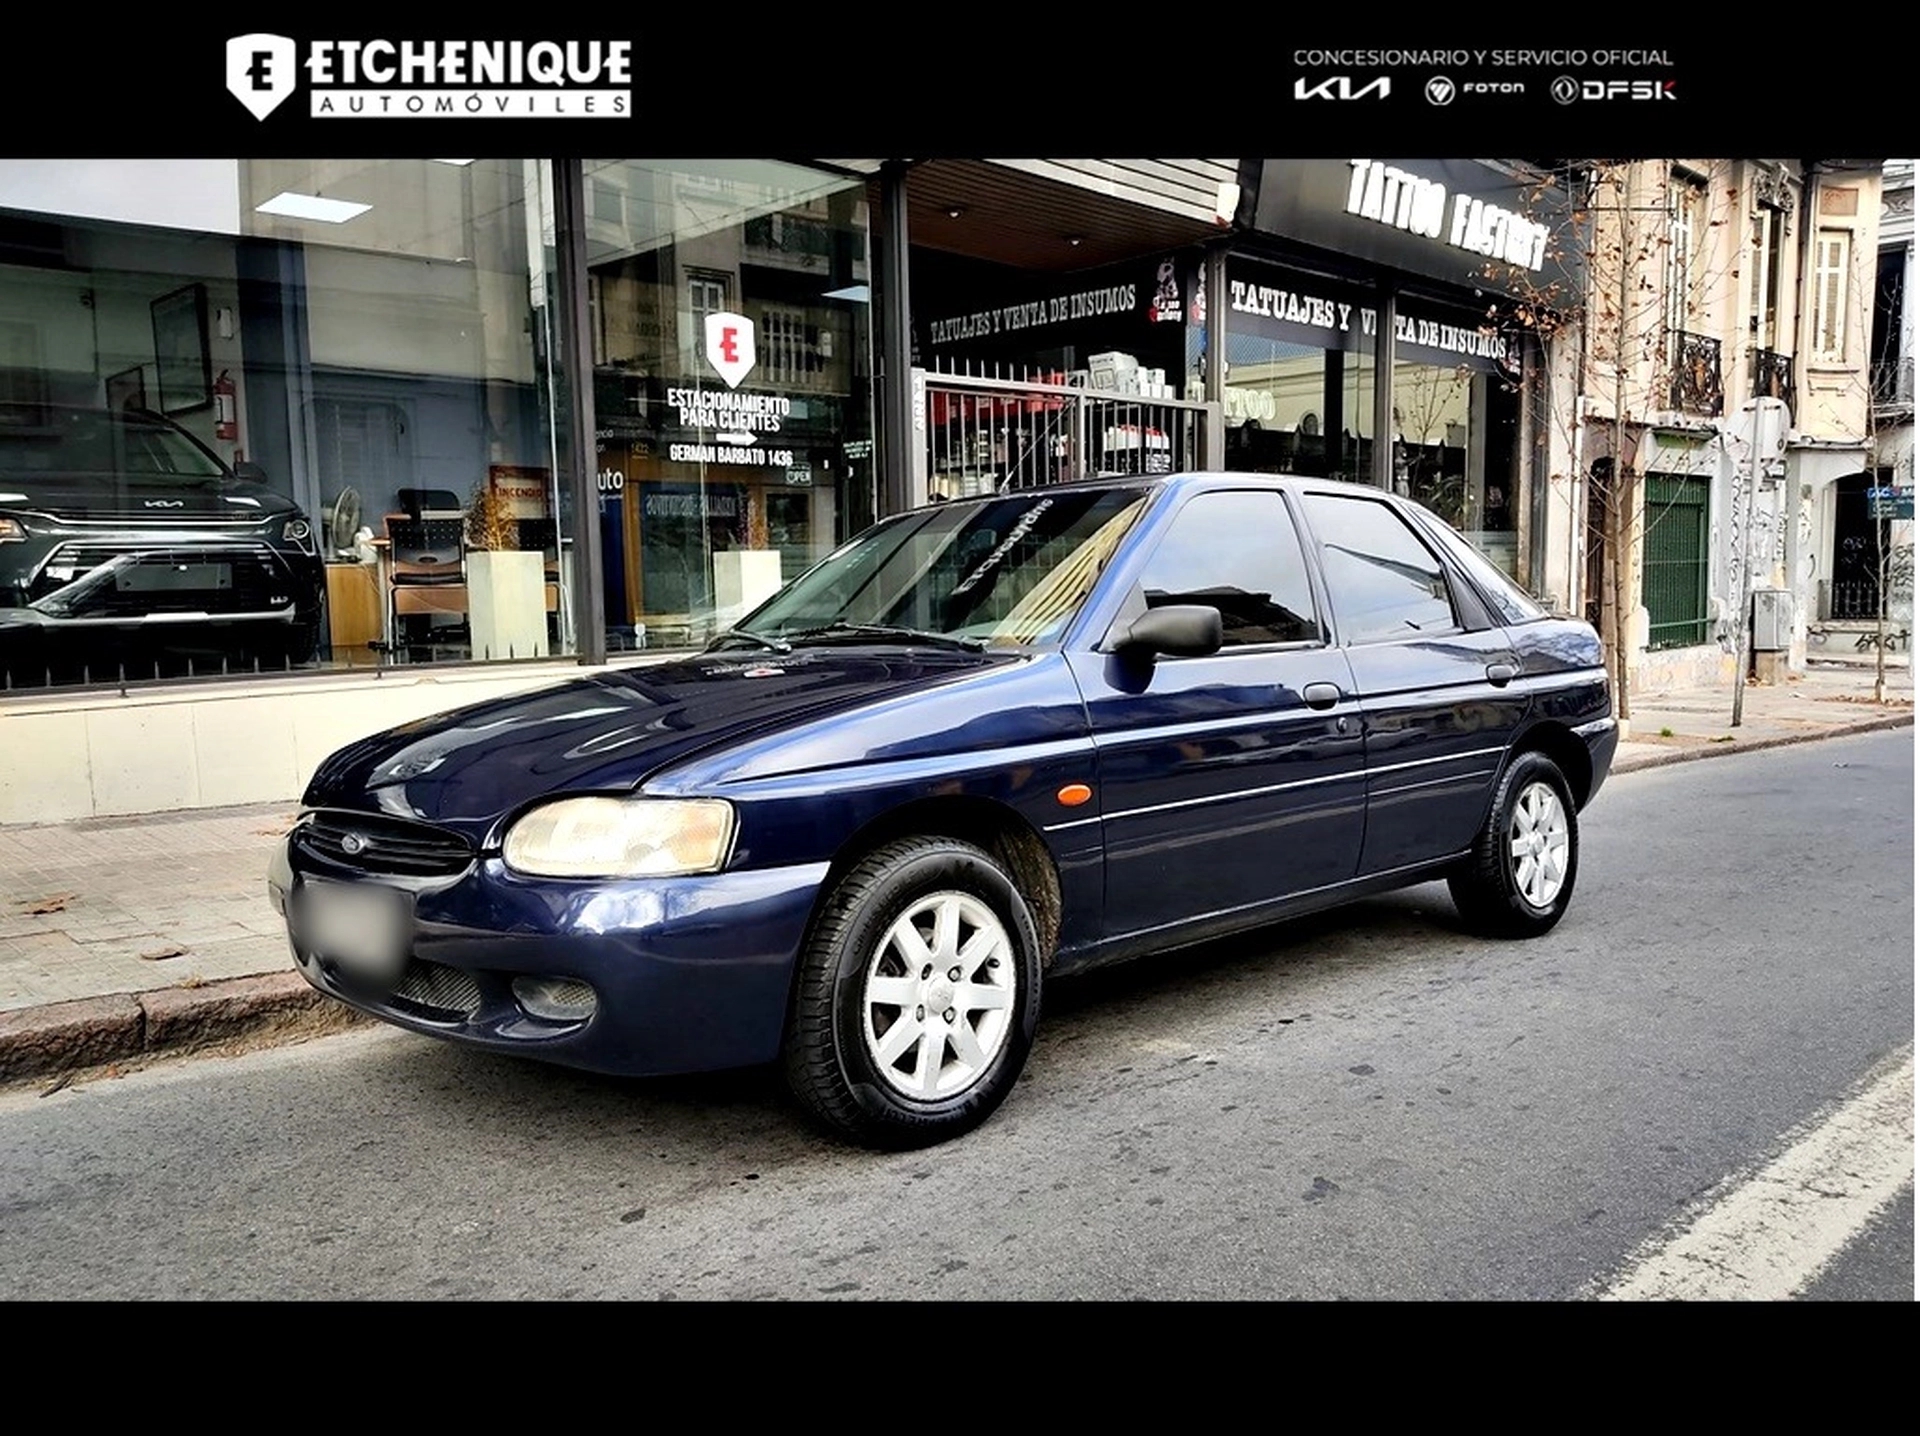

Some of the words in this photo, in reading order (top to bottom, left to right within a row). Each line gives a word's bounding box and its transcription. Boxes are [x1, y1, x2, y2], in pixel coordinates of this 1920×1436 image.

[1346, 158, 1446, 239] TATTOO
[1449, 193, 1550, 272] FACTORY
[931, 311, 990, 344] TATUAJES
[992, 309, 1001, 333] Y
[1003, 300, 1047, 331] VENTA
[1050, 296, 1068, 322] DE
[1070, 284, 1136, 319] INSUMOS
[1231, 280, 1335, 329] TATUAJES
[1337, 302, 1352, 332] Y
[1360, 307, 1417, 343] VTA
[1418, 318, 1439, 347] DE
[1439, 322, 1507, 360] INSUMOS
[667, 388, 790, 416] ESTACIONAMIENTO
[680, 406, 717, 428] PARA
[719, 409, 781, 432] CLIENTES
[670, 443, 716, 463] GERMAN
[717, 446, 766, 466] BARBATO
[768, 450, 794, 467] 1436
[498, 487, 543, 499] INCENDIO
